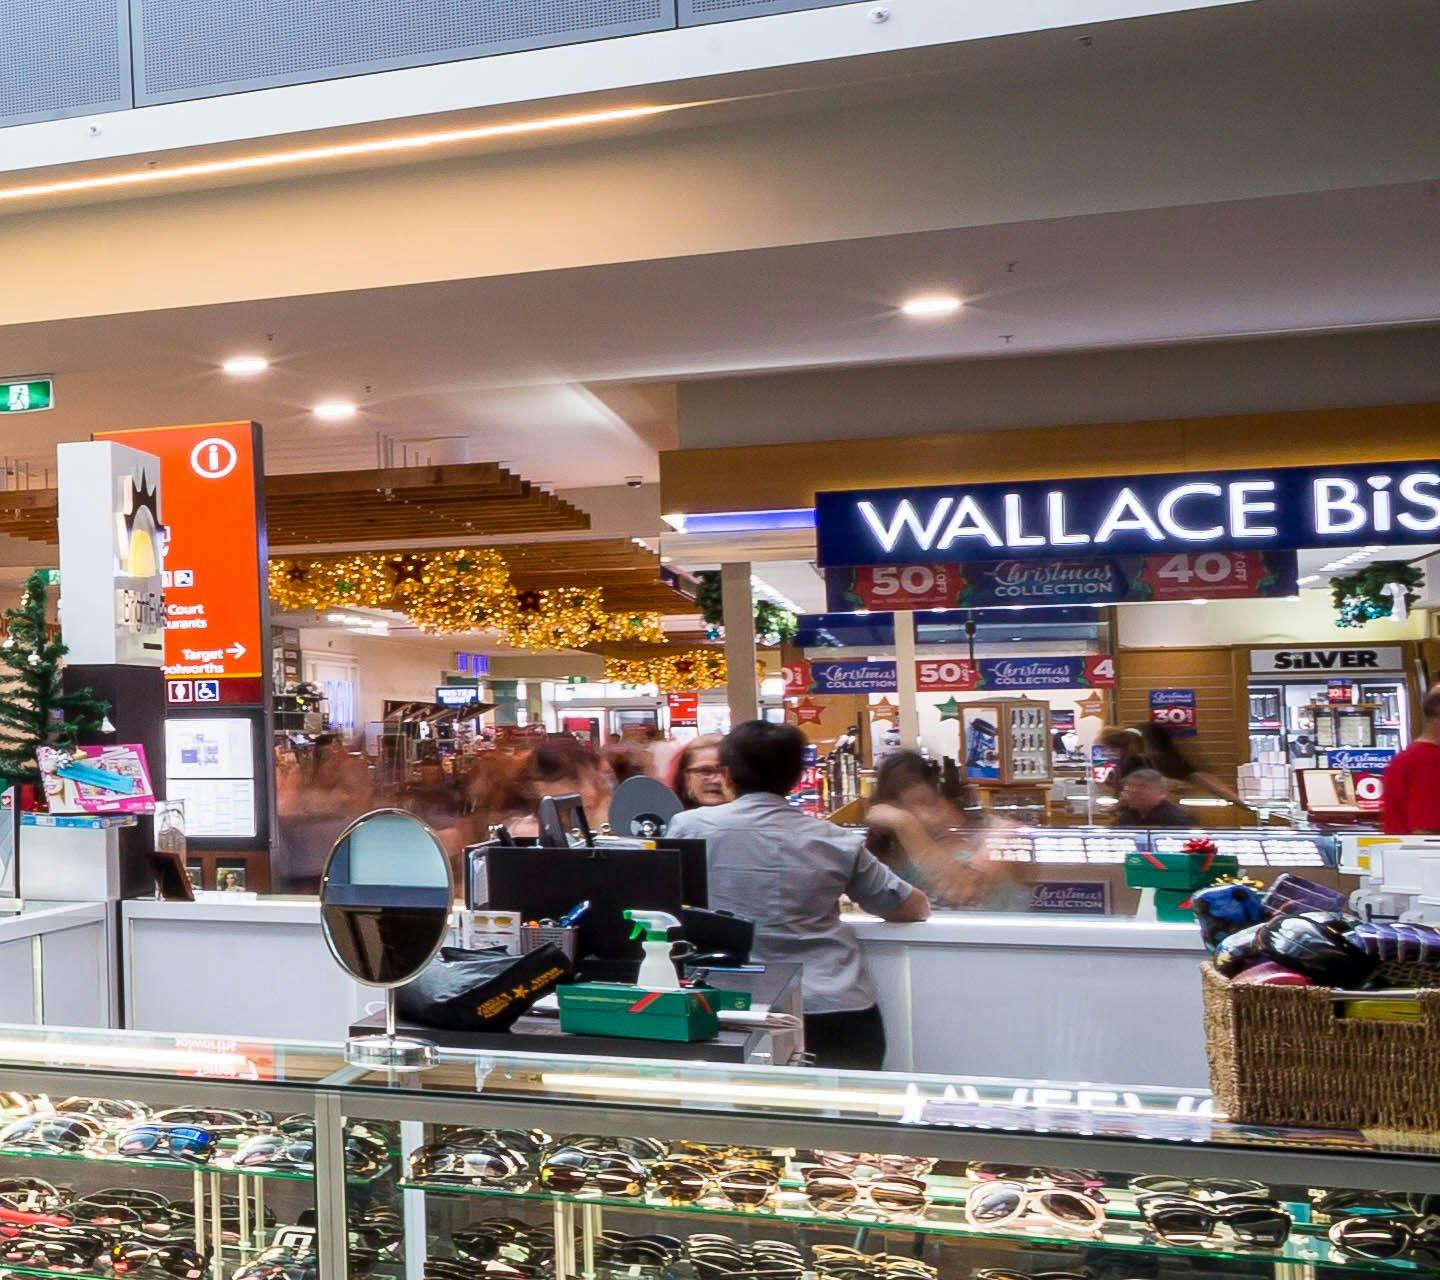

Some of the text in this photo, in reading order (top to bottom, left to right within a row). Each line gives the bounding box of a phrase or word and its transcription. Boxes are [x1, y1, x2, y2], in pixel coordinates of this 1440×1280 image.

[857, 480, 1278, 554] WALLACE
[985, 559, 1113, 586] Christmas
[1157, 551, 1231, 584] 40
[871, 566, 934, 596] 50
[994, 582, 1113, 597] COLLECTION
[168, 603, 205, 615] Court
[182, 648, 224, 662] Target
[920, 663, 961, 683] 50
[988, 660, 1070, 679] Christmas
[826, 679, 896, 689] COLLECTION
[995, 674, 1070, 686] COLLECTION
[1153, 709, 1186, 723] 30
